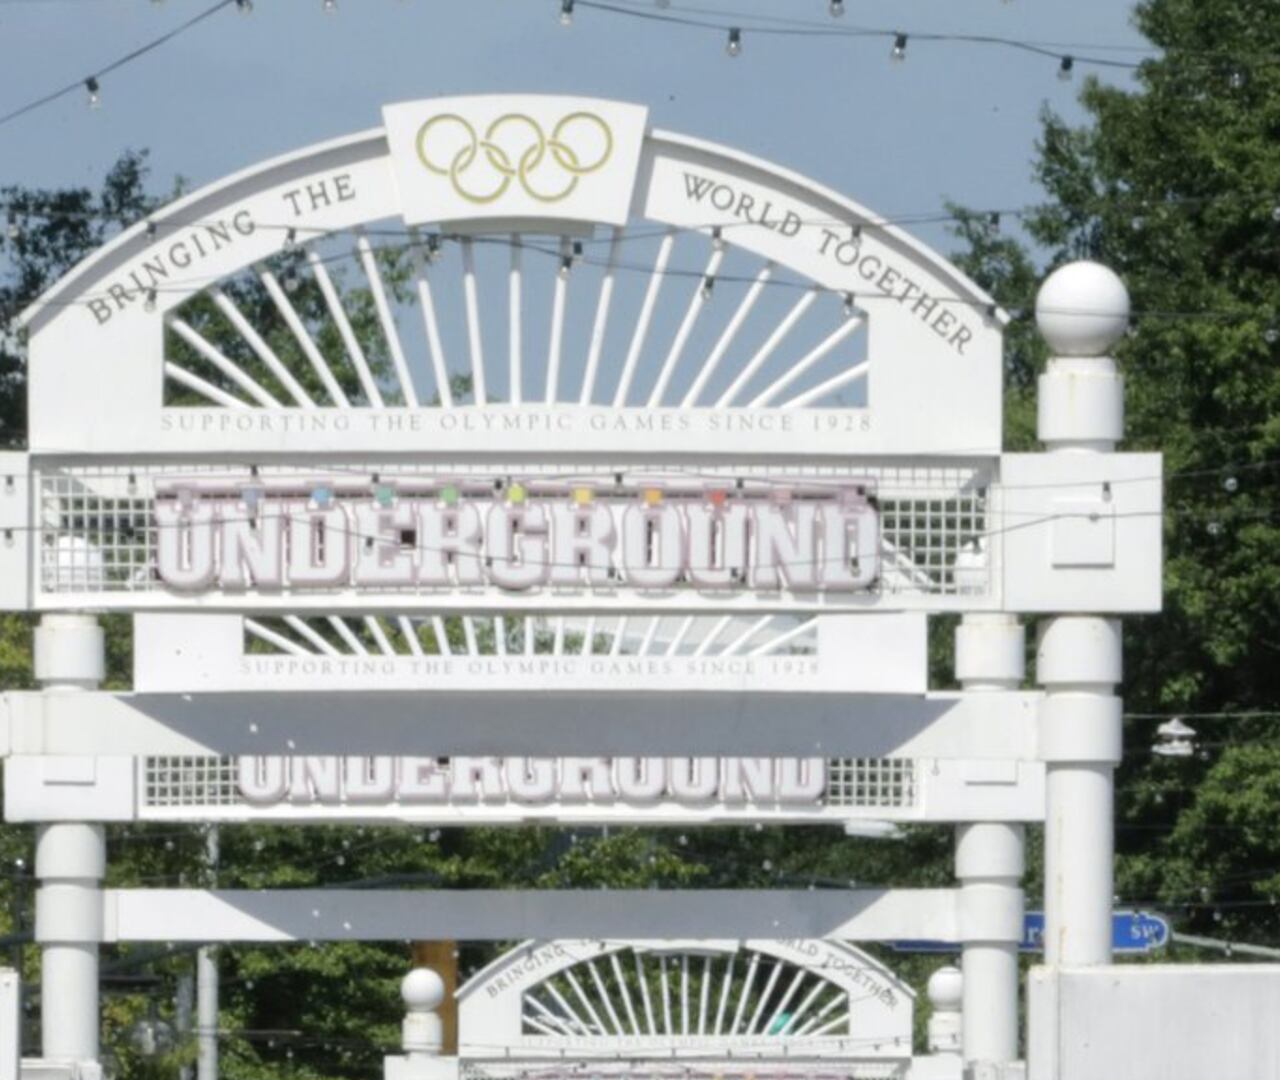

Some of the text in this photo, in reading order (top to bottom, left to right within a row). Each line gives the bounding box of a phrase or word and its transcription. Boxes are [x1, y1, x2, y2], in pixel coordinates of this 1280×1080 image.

[86, 171, 974, 355] BRINGING THE WORLD TOGETHER
[159, 412, 872, 433] SUPPORTING THE OLYMPIC GAMES SINCE 1928
[154, 494, 881, 592] UNDERGROUND
[239, 658, 397, 676] SUPPORTING
[410, 658, 454, 676] THE
[468, 658, 579, 676] OLYMPIC
[589, 658, 674, 676] GAMES
[686, 658, 757, 676] SINCE
[237, 756, 829, 808] UNDERGROUND
[485, 944, 567, 999] BRINGING
[823, 952, 900, 1009] TOGETHER
